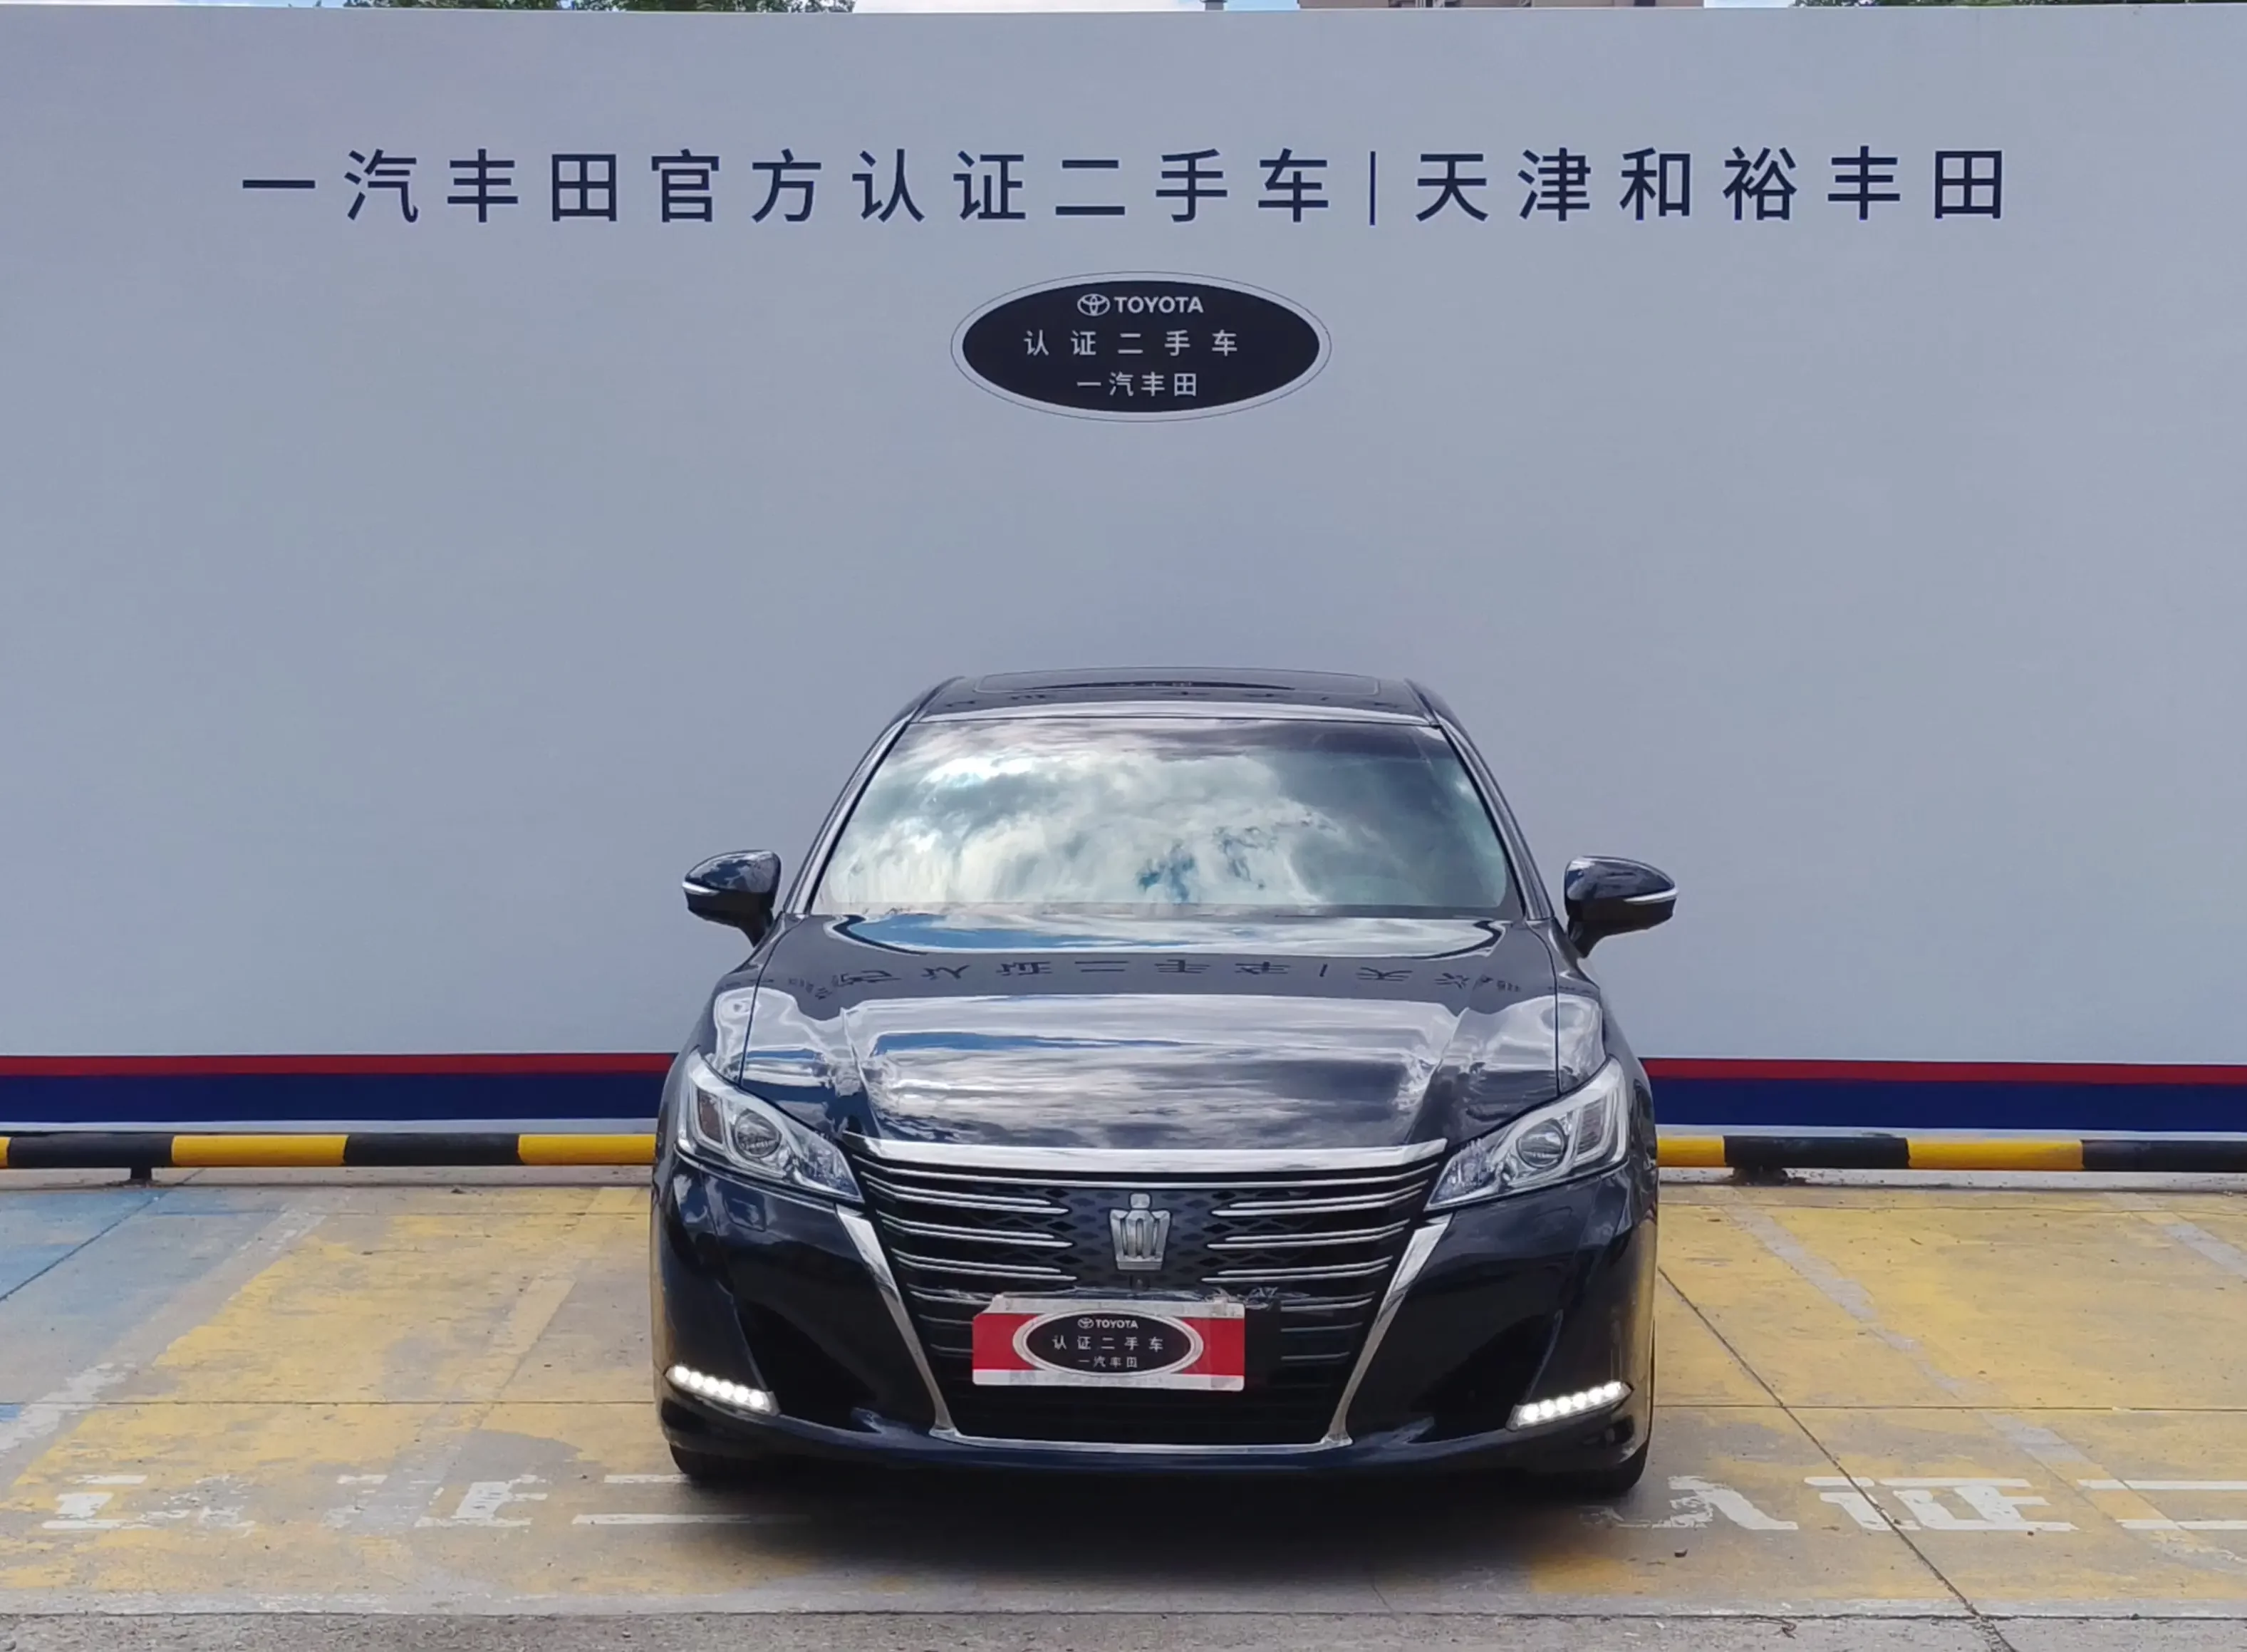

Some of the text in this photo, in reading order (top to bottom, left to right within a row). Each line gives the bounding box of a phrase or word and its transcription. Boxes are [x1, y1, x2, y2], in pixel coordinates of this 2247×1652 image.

[1114, 296, 1204, 314] TOYOTA
[1024, 329, 1238, 357] 认证二手车
[1076, 371, 1197, 397] 一汽丰田
[1095, 1319, 1139, 1329] TOYOTA
[1052, 1335, 1163, 1353] 认证二手车
